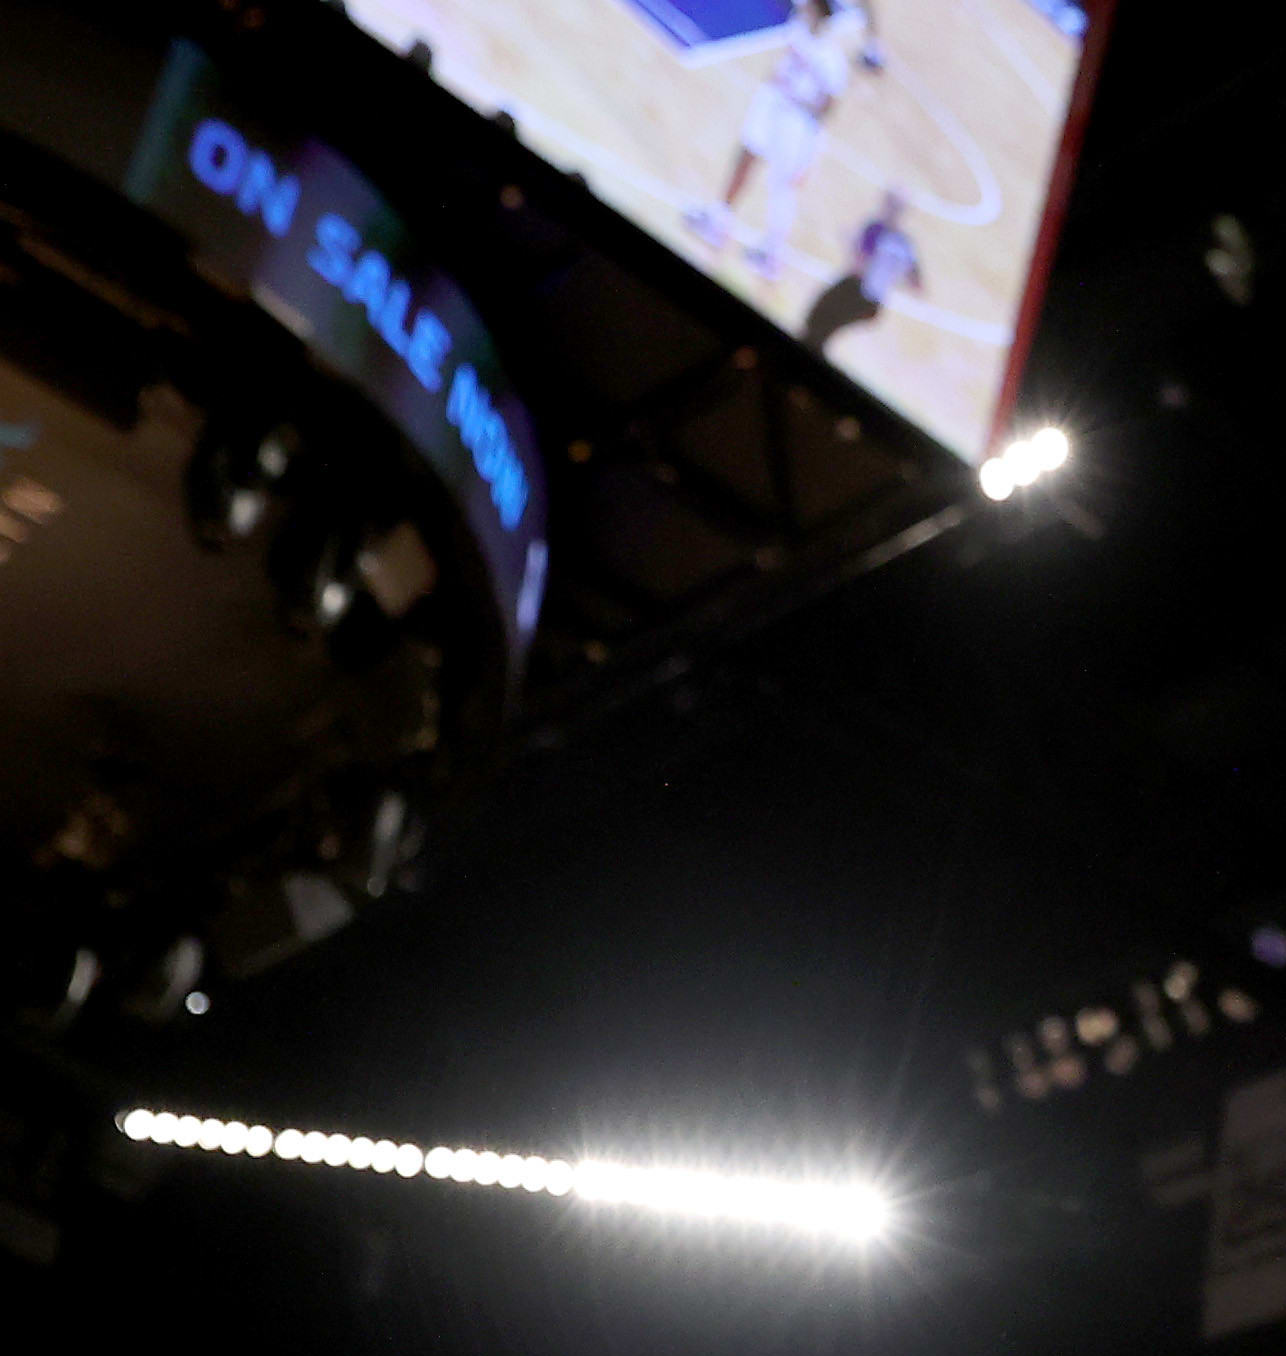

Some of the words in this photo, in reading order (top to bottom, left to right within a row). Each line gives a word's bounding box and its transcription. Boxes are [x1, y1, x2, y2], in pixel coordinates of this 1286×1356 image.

[188, 117, 302, 238] ON
[305, 212, 453, 394] SALE
[445, 361, 530, 532] NOW
